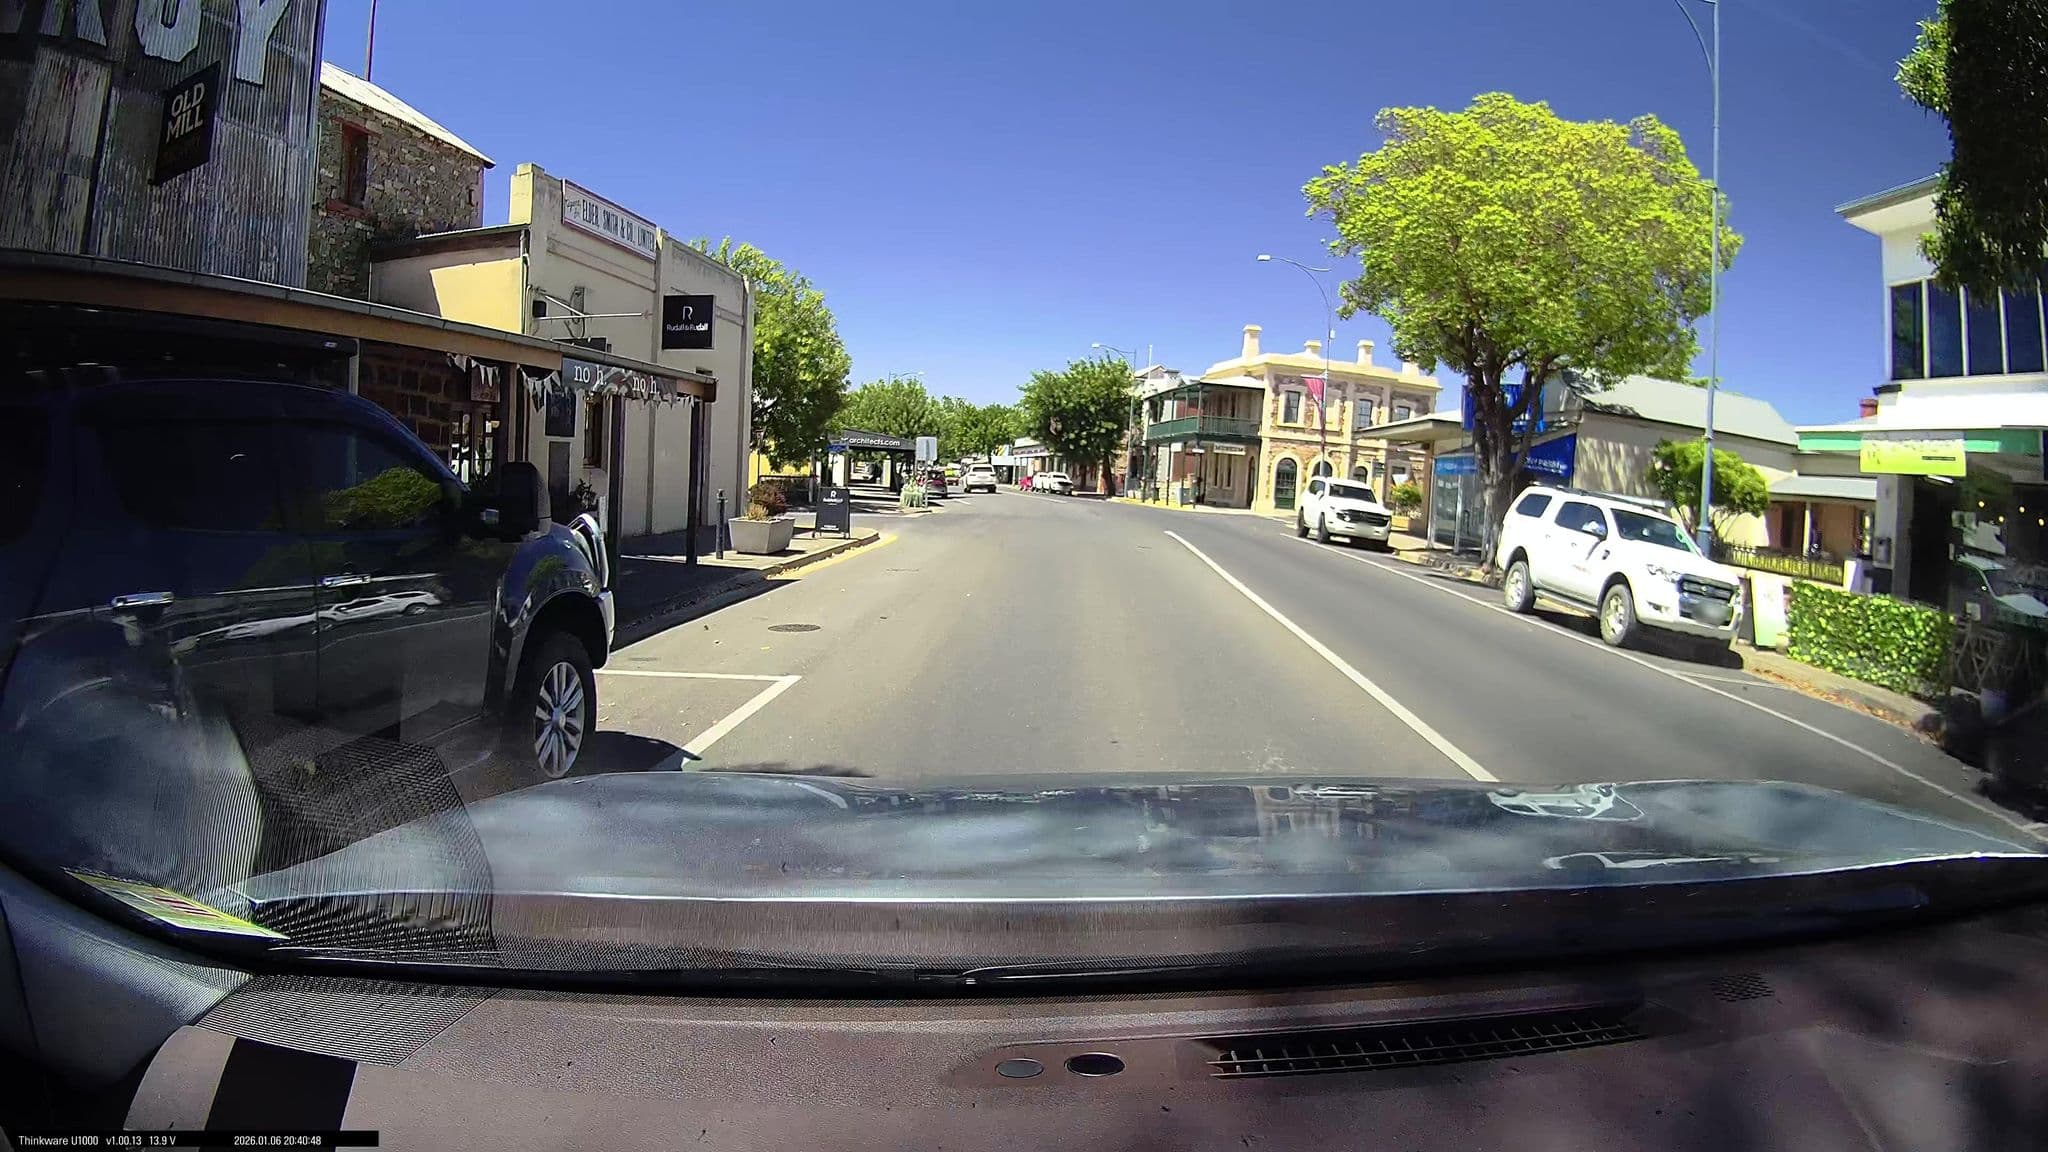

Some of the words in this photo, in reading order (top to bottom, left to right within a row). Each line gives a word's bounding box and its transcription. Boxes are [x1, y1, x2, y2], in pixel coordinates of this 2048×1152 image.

[171, 82, 205, 118] OLD
[165, 105, 204, 145] MILL
[620, 218, 626, 239] &
[682, 305, 693, 321] R
[574, 365, 591, 384] no
[632, 375, 646, 393] no
